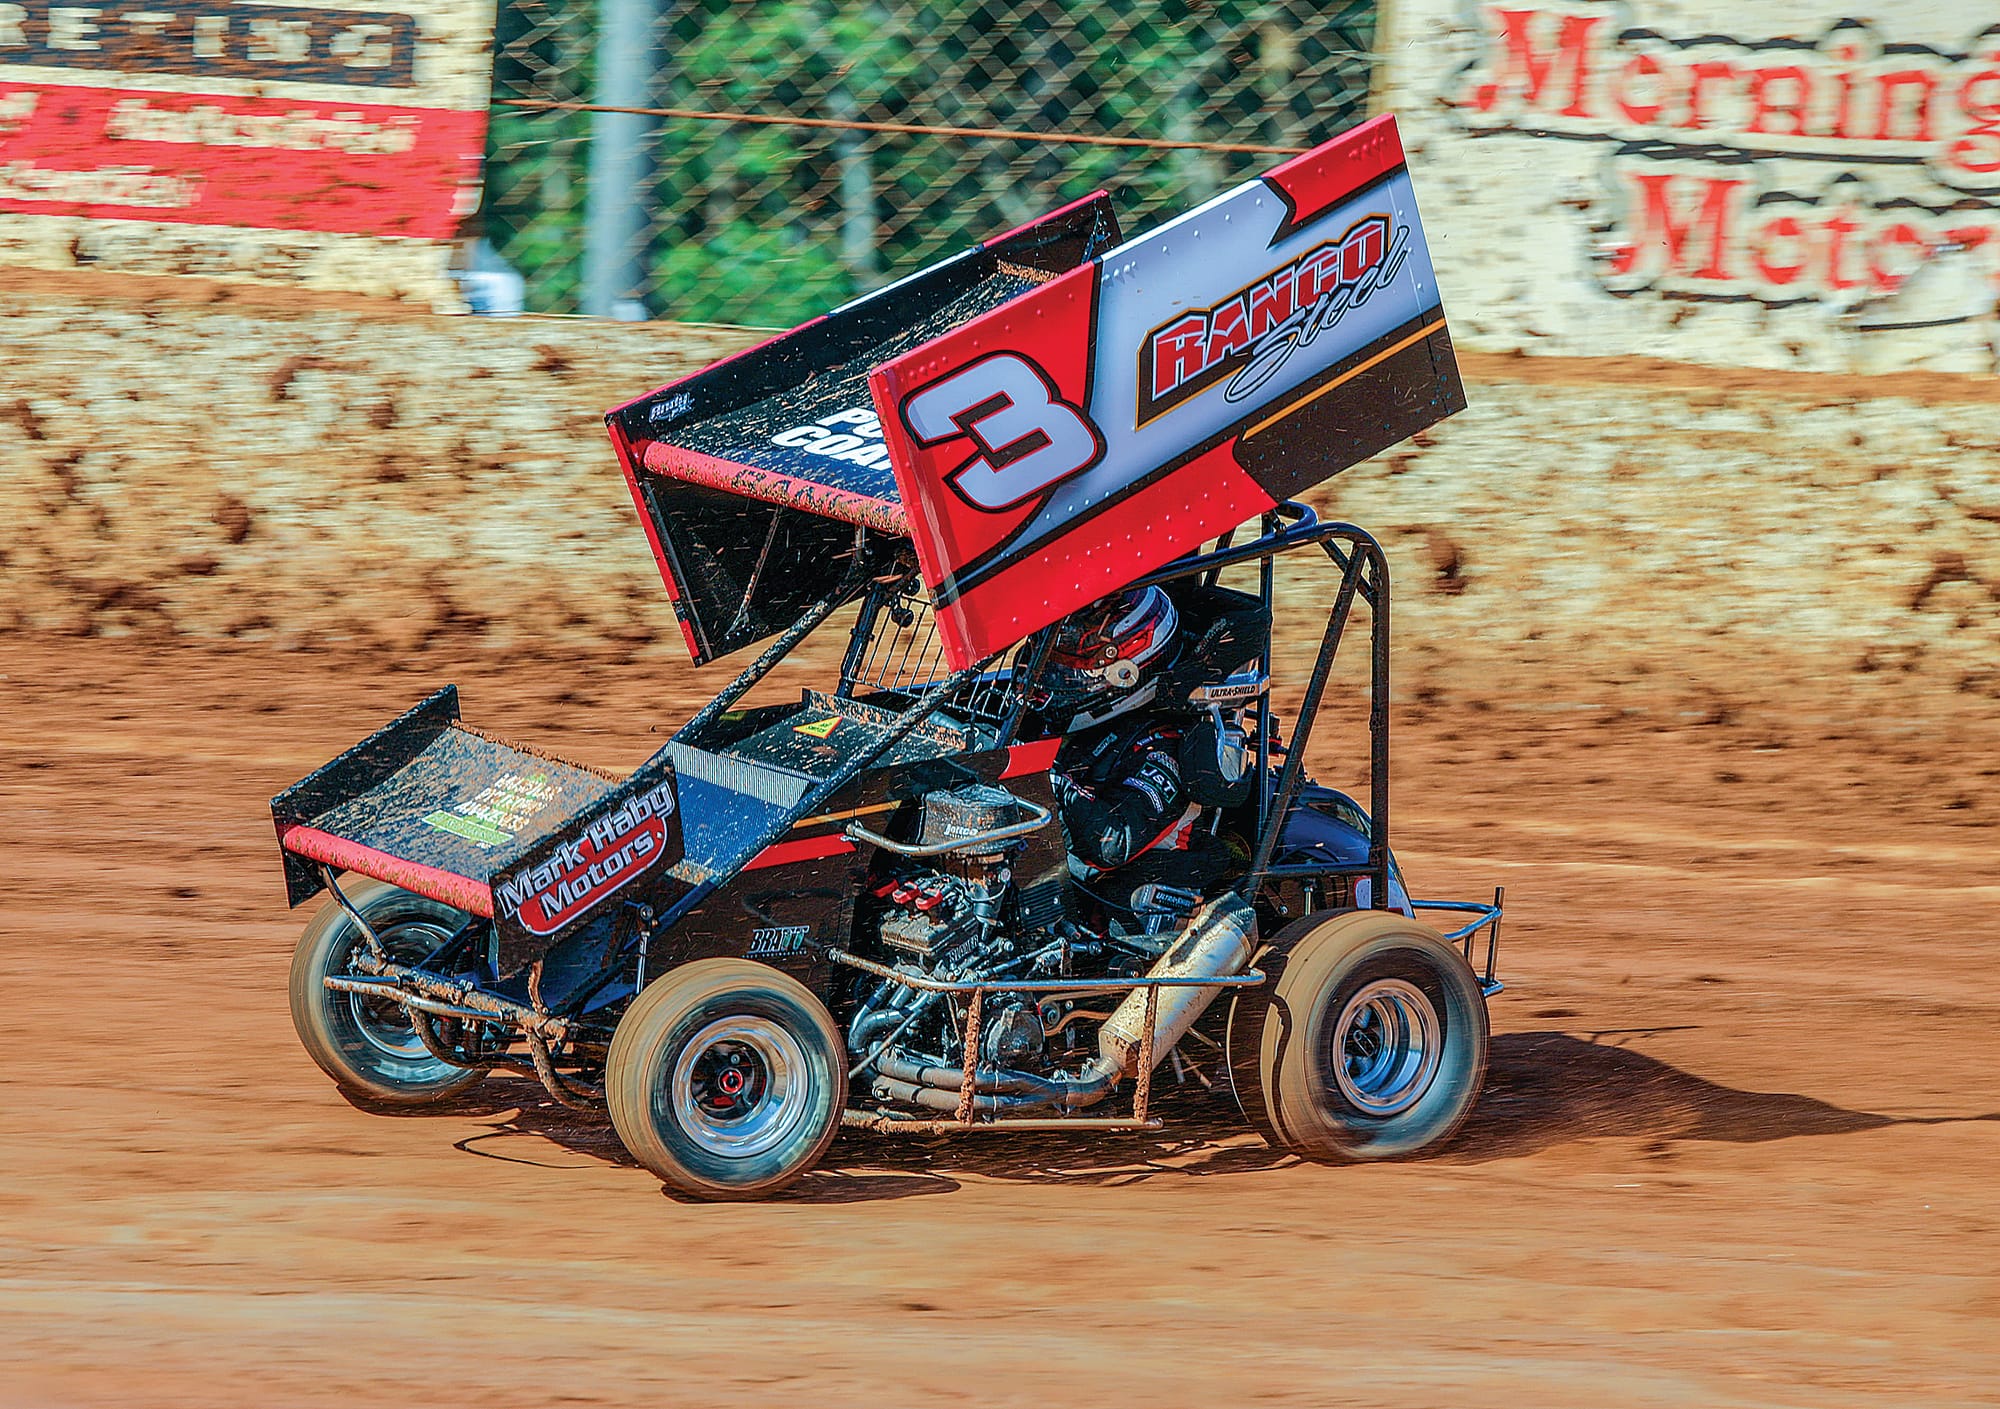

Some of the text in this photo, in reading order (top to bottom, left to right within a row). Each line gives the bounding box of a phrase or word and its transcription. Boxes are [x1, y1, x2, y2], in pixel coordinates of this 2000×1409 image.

[1150, 217, 1388, 402] RANCO
[1223, 224, 1412, 404] Steel
[902, 352, 1103, 511] 3
[495, 836, 587, 920] Mark
[583, 780, 676, 853] Haby
[539, 830, 656, 922] Motors
